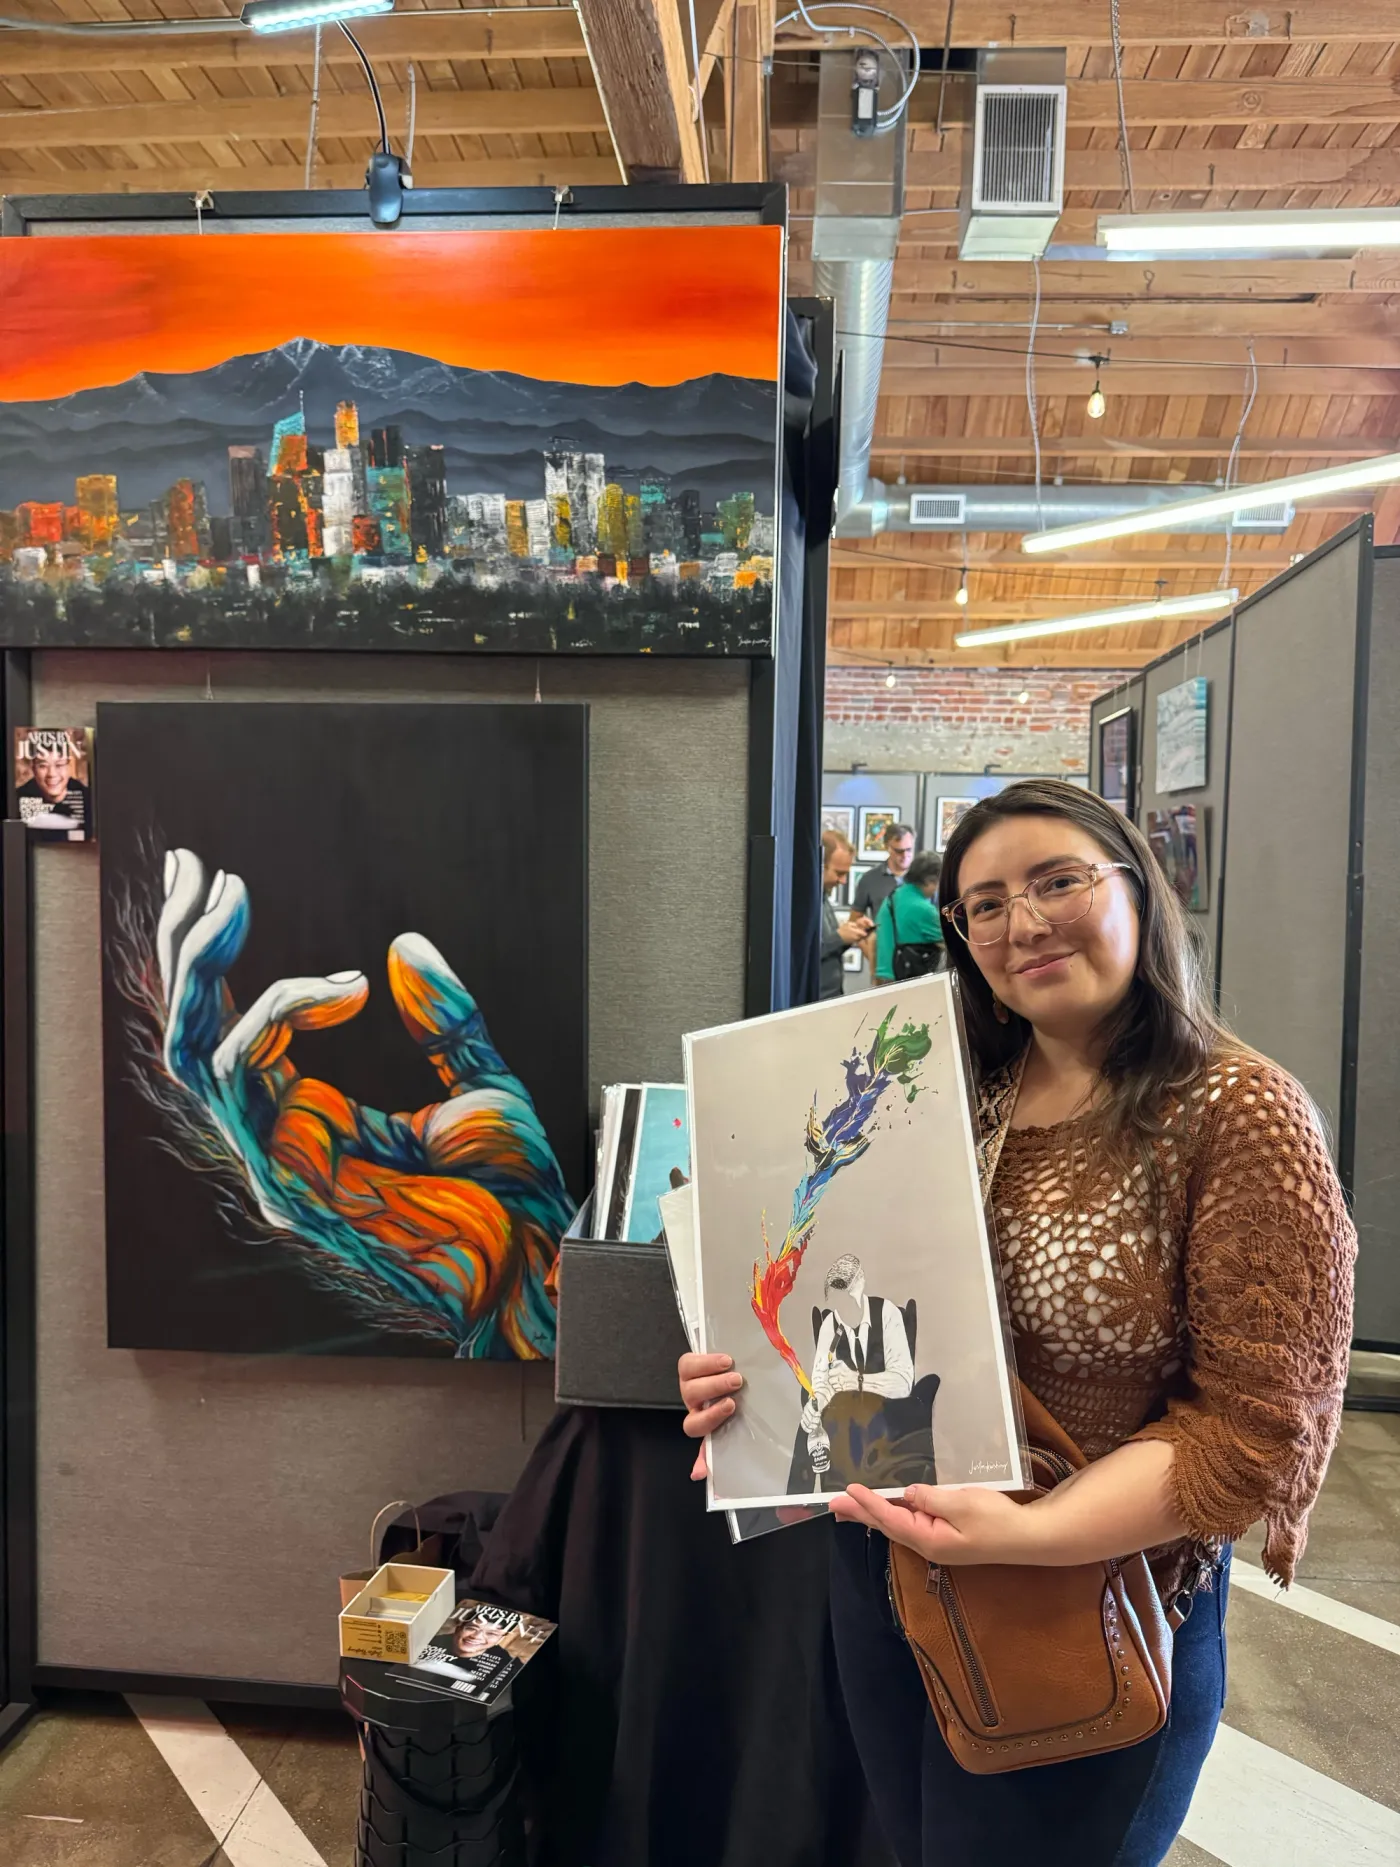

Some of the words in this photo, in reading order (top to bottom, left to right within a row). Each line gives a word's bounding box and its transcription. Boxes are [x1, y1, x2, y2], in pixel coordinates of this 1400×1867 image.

[16, 740, 85, 760] JUSTIN
[450, 1608, 534, 1638] JUSTIN
[475, 1604, 508, 1620] ARTS
[505, 1611, 526, 1622] BY
